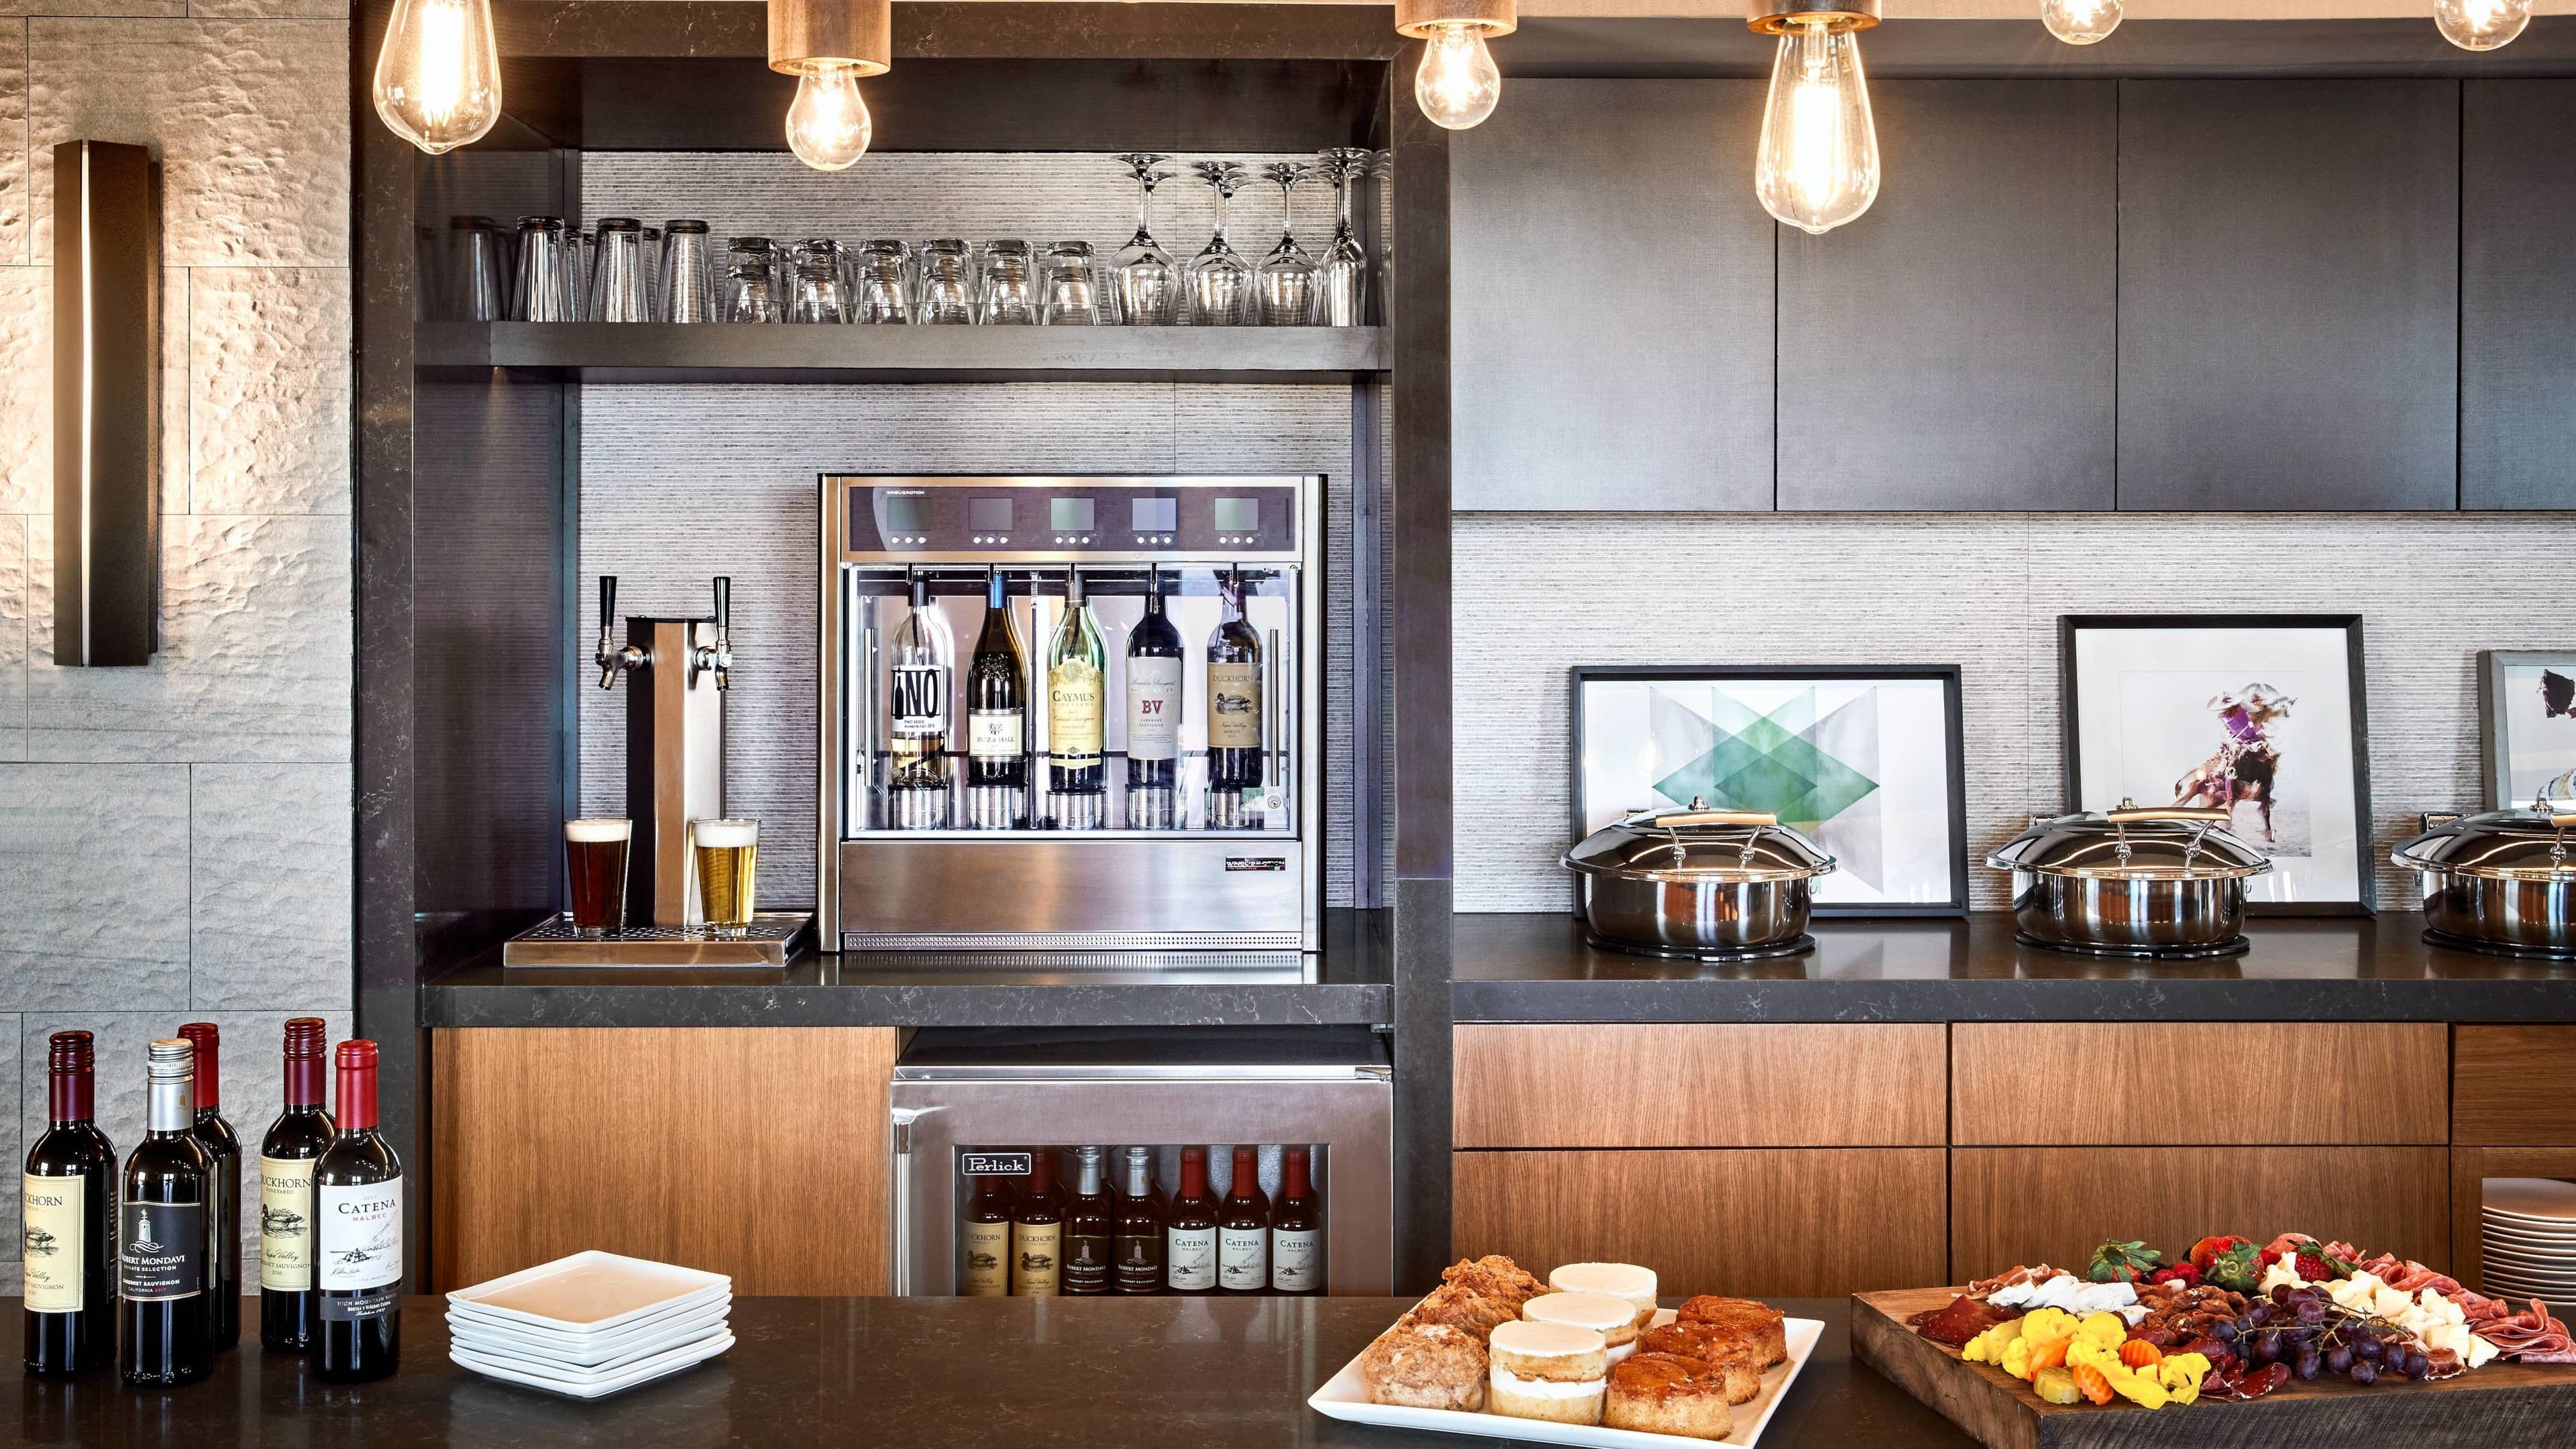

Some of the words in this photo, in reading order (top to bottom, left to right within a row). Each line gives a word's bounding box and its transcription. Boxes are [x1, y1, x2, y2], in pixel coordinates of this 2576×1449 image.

[1053, 691, 1095, 702] CAYMUS
[1142, 700, 1163, 714] BV
[338, 1199, 396, 1214] CATENA
[353, 1213, 387, 1222] MALBEC
[1019, 1234, 1056, 1242] DUCKHORN
[1175, 1238, 1208, 1246] CATENA
[1226, 1238, 1258, 1246] CATENA
[1280, 1240, 1314, 1248] CATENA
[141, 1255, 185, 1265] MONDAVI
[275, 1249, 299, 1263] Valley
[354, 1296, 385, 1305] MOUNTAIN
